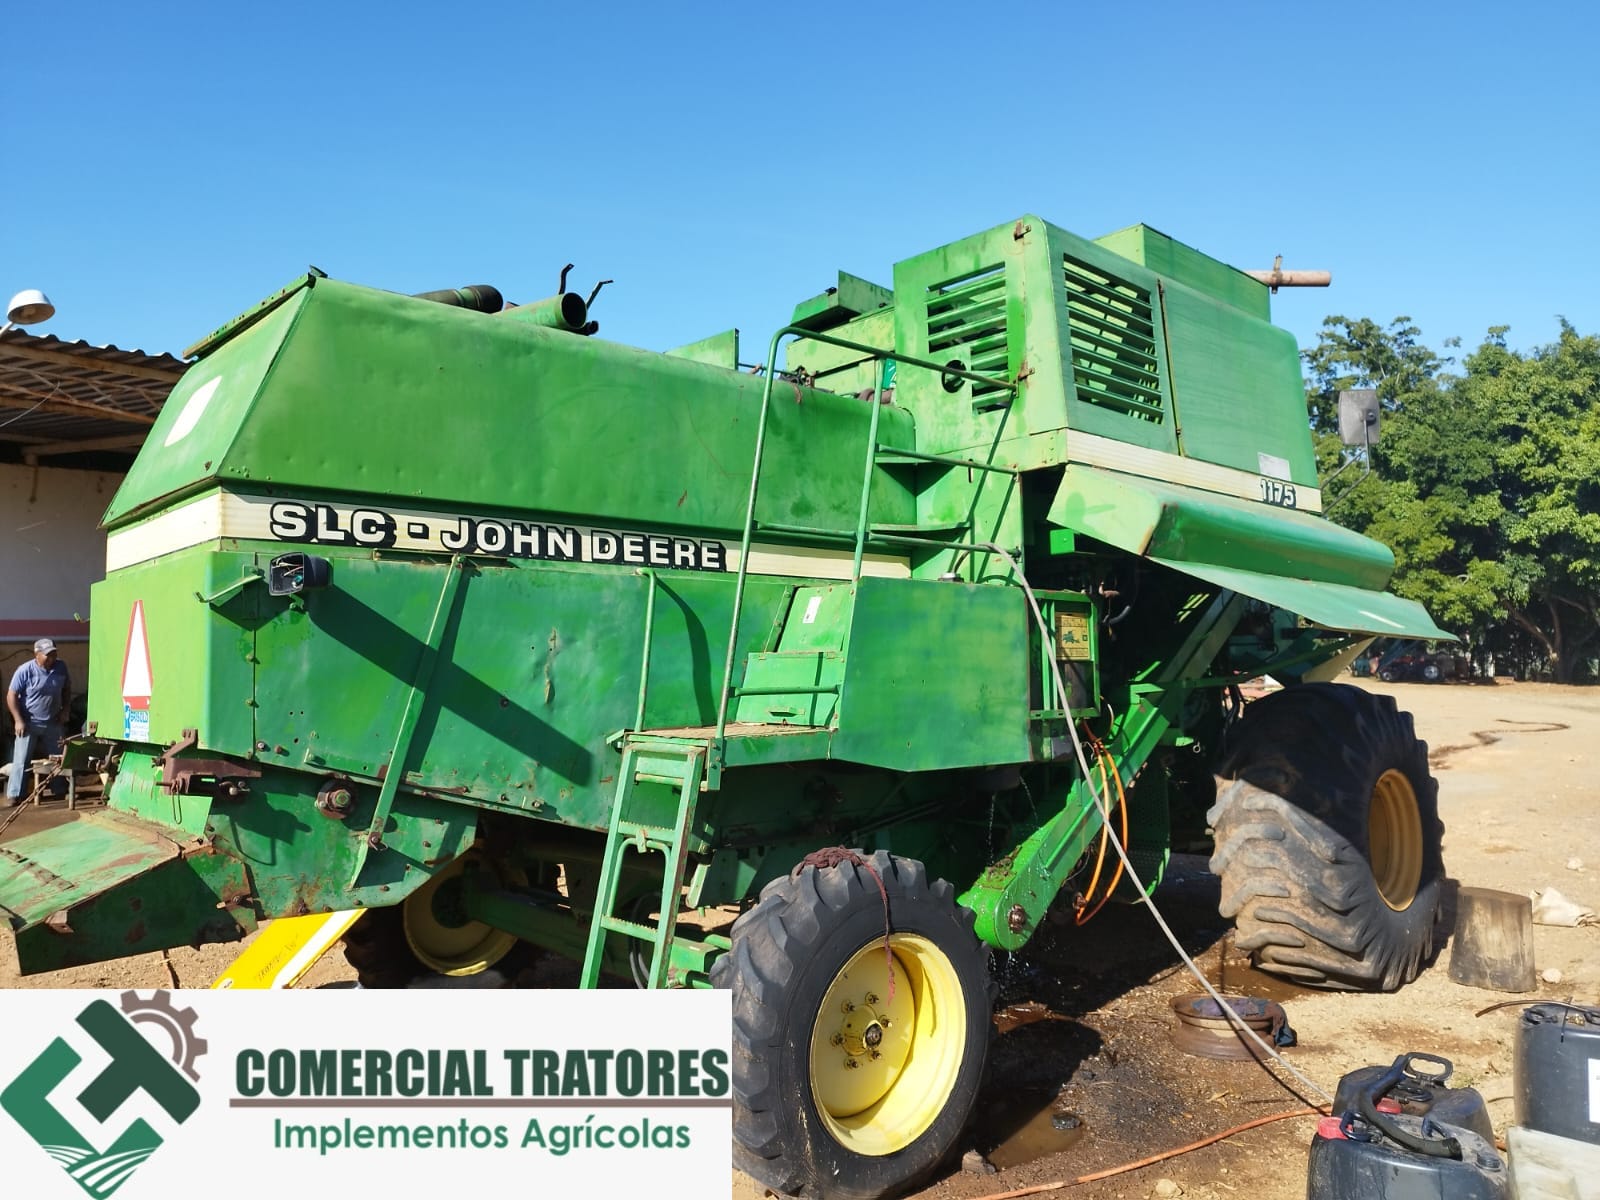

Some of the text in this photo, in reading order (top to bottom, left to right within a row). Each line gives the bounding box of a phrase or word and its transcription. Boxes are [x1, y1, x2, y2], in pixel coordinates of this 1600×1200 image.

[1260, 478, 1297, 509] 1175
[270, 501, 397, 548] SLC
[440, 517, 583, 562] JOHN
[590, 530, 728, 572] DEERE
